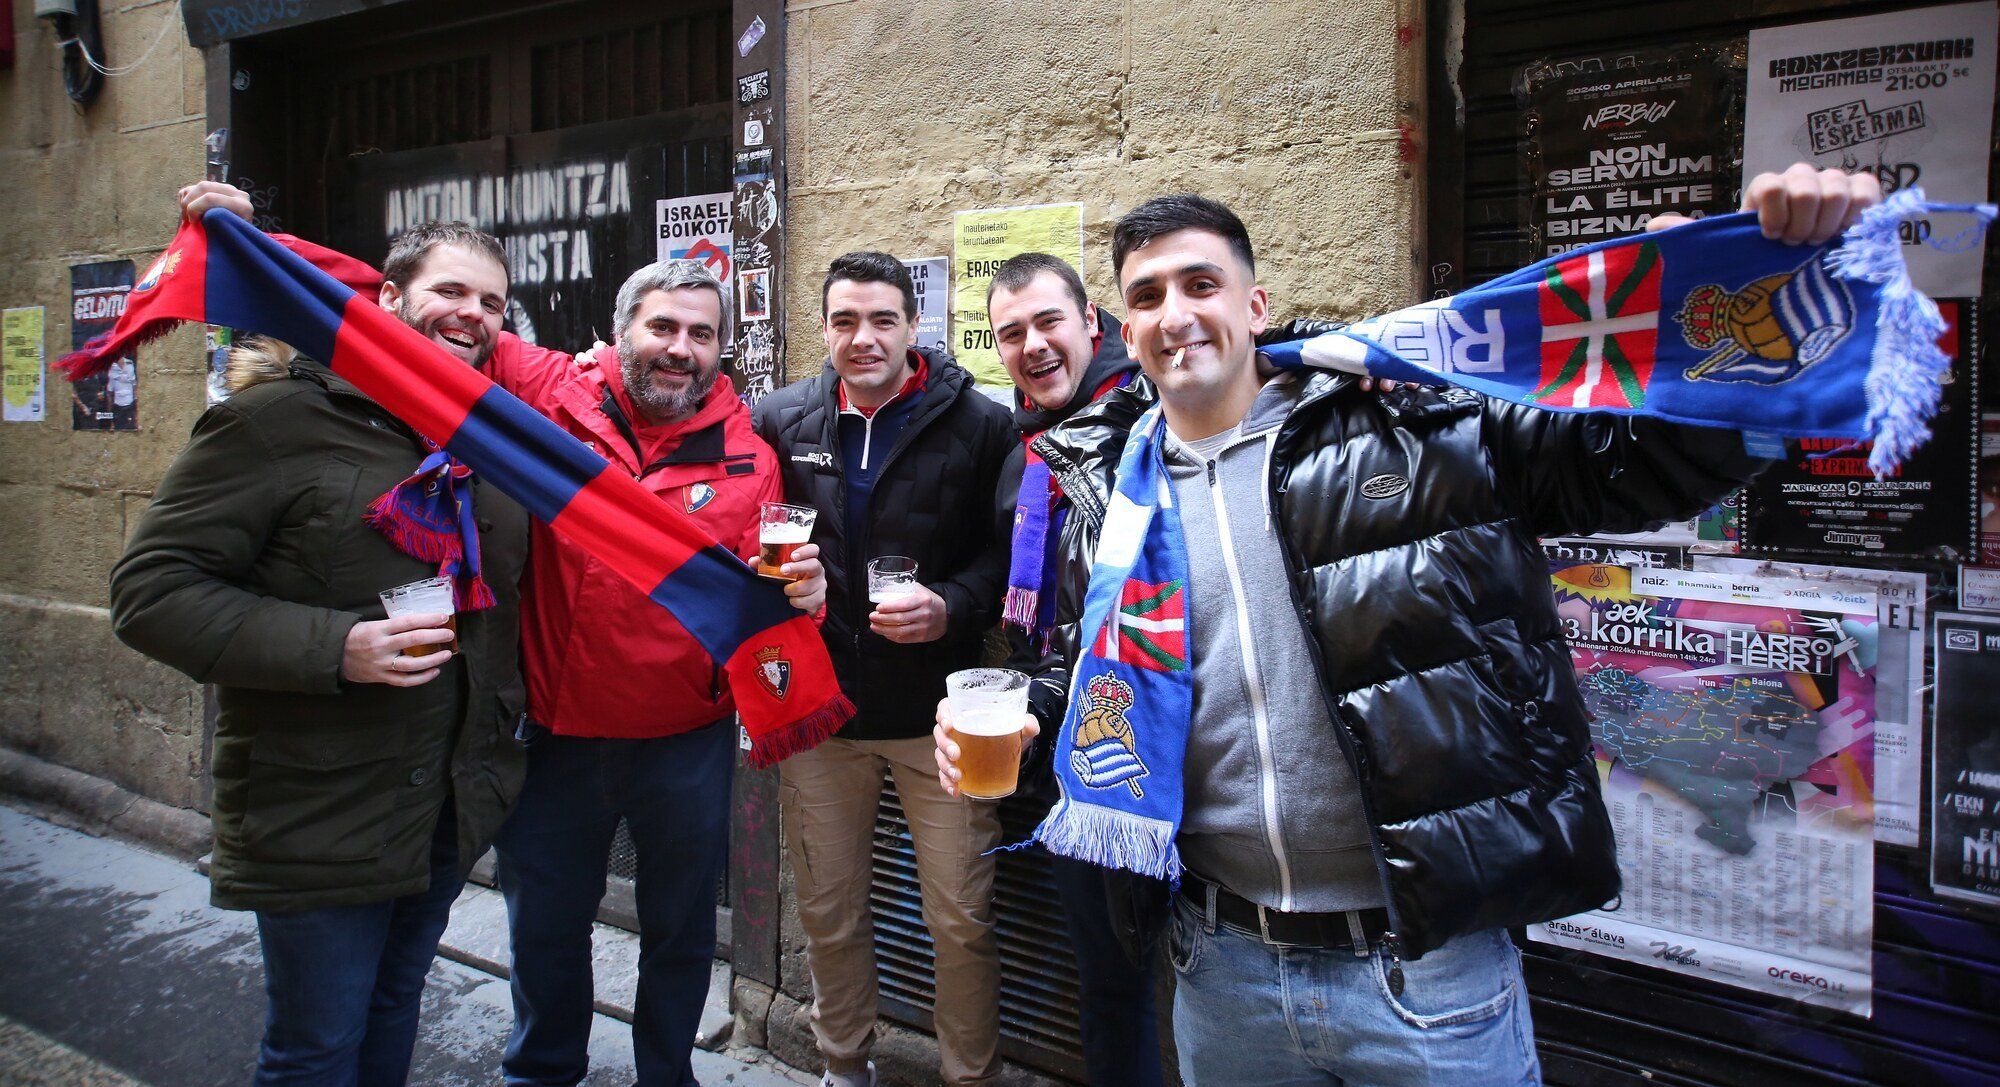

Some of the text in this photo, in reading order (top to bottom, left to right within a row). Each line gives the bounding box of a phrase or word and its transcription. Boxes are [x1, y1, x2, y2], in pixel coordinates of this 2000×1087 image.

[1885, 72, 1948, 93] 21:00
[1813, 106, 1922, 150] ESPERMA
[1590, 142, 1667, 167] NON
[1547, 155, 1713, 186] SERVIUM
[1547, 184, 1713, 214] LA ÉLITE
[1547, 209, 1706, 238] BIZNAA
[1847, 481, 1861, 496] 9
[1824, 531, 1861, 546] Jimmy
[1641, 575, 1669, 587] naiz:
[1732, 583, 1760, 593] berria
[1610, 645, 1636, 655] 2024ko
[1637, 649, 1678, 660] martxoaren
[1679, 653, 1698, 662] 14tik
[1699, 655, 1716, 664] 24ra
[1698, 677, 1716, 688] Irun
[1751, 677, 1783, 689] Baiona
[1548, 920, 1625, 944] araba álava
